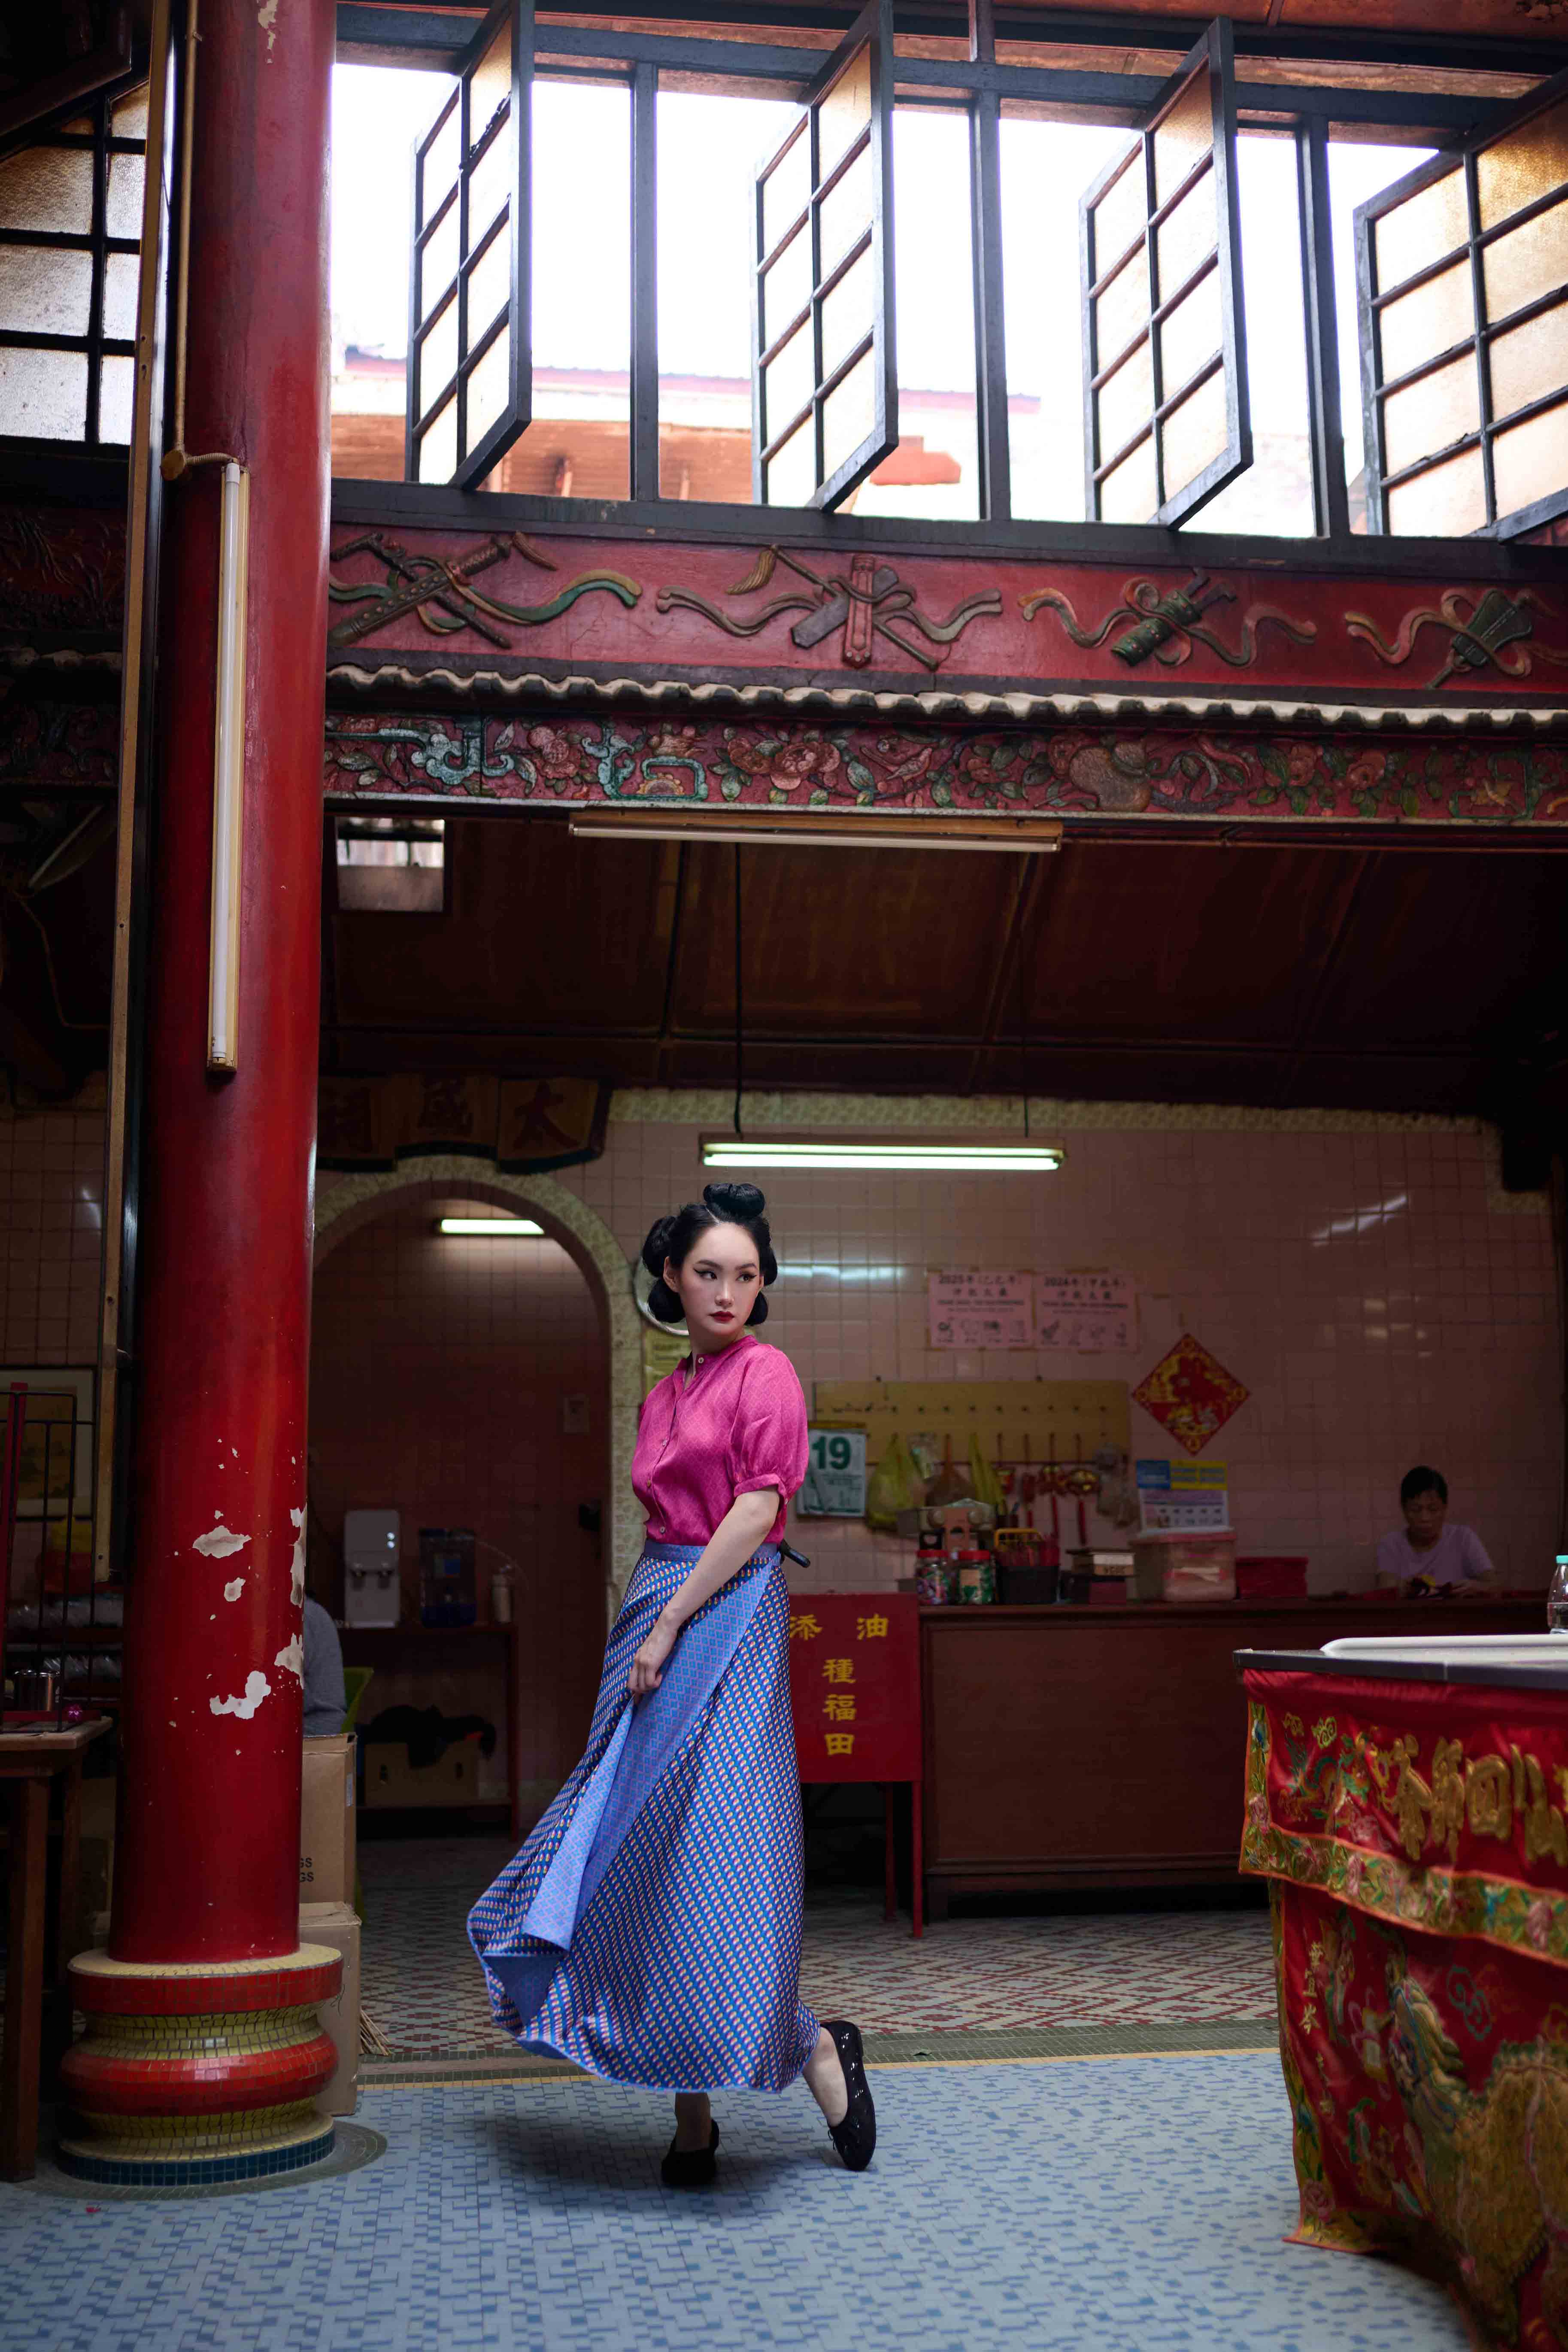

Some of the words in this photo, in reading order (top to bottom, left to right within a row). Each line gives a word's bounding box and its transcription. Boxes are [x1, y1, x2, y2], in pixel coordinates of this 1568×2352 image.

[813, 1436, 851, 1470] 19
[822, 1658, 858, 1758] 種福田
